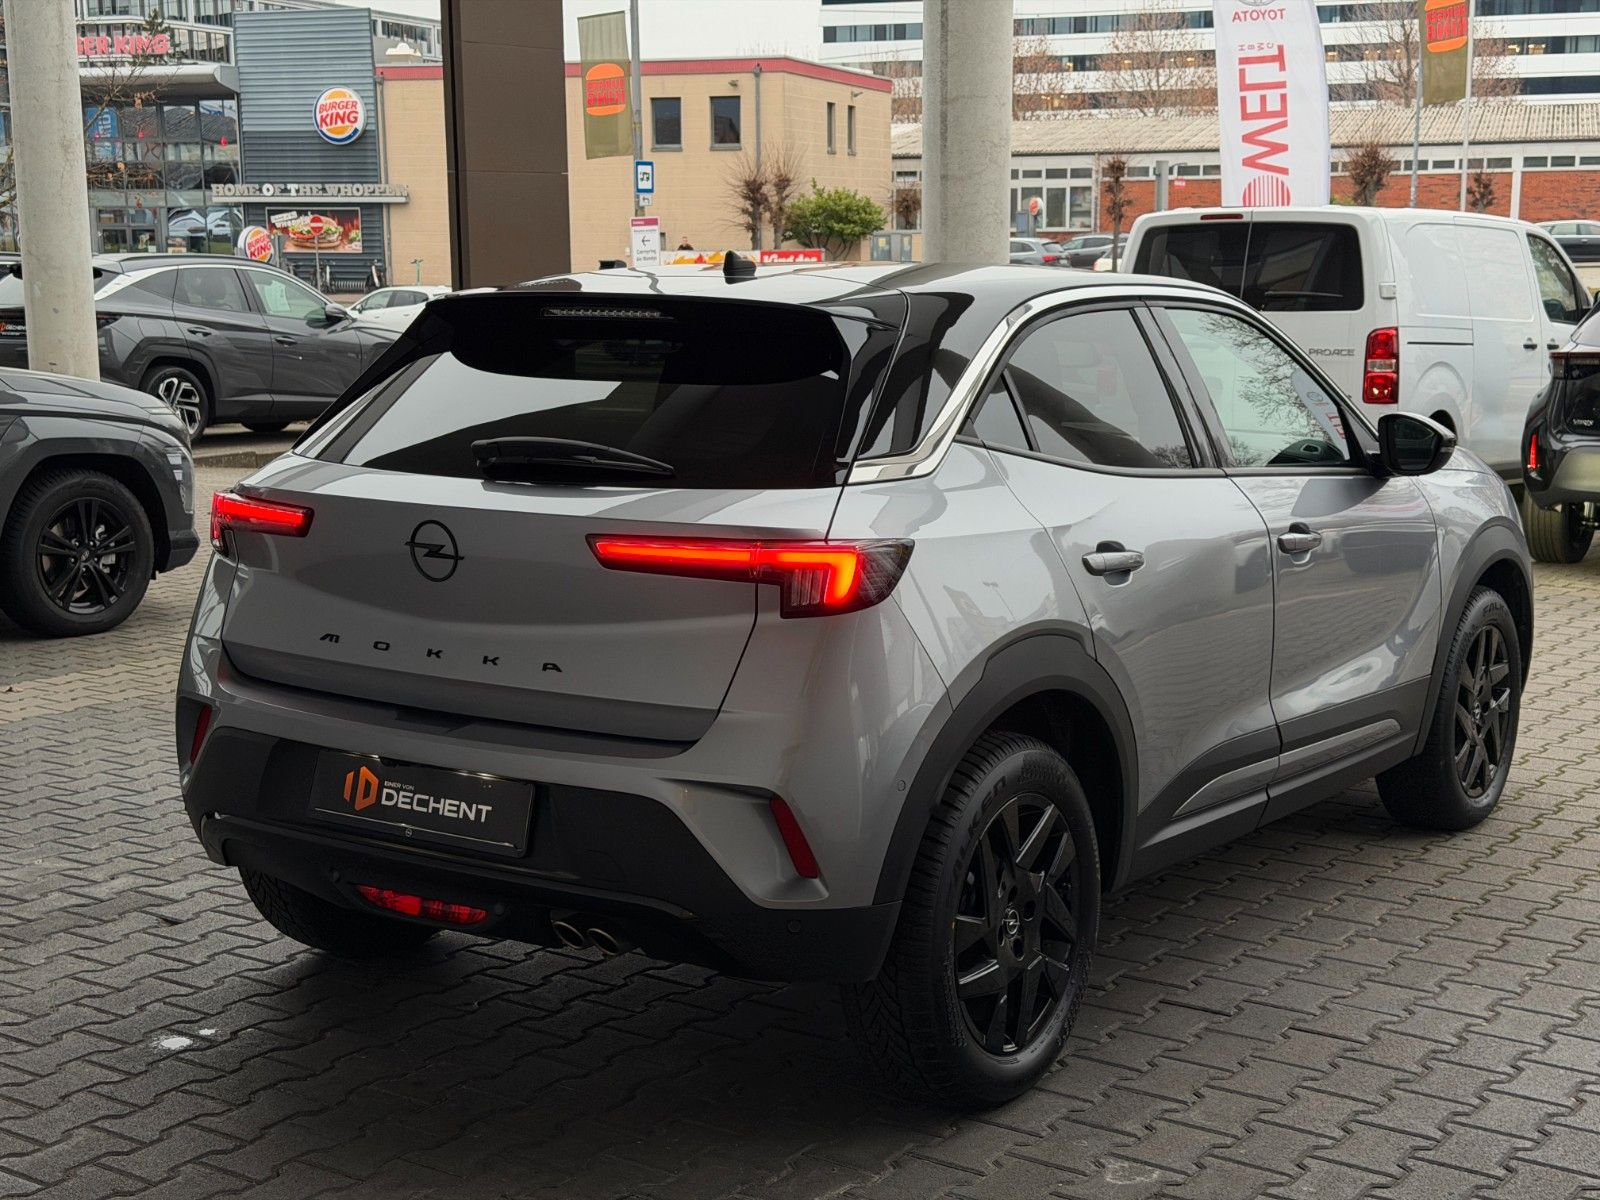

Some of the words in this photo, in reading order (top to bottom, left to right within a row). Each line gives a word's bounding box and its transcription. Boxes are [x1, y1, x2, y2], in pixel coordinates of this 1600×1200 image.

[114, 33, 169, 55] KING
[319, 100, 358, 114] BURGER
[320, 110, 359, 128] KING
[211, 183, 260, 196] HOME
[262, 183, 285, 196] OF
[286, 183, 322, 197] THE
[324, 183, 408, 197] WHOPPER
[250, 242, 272, 258] KING
[1309, 348, 1355, 356] PROACE
[319, 633, 563, 673] MOKKA
[384, 780, 401, 788] EINER
[381, 788, 493, 823] DECHENT
